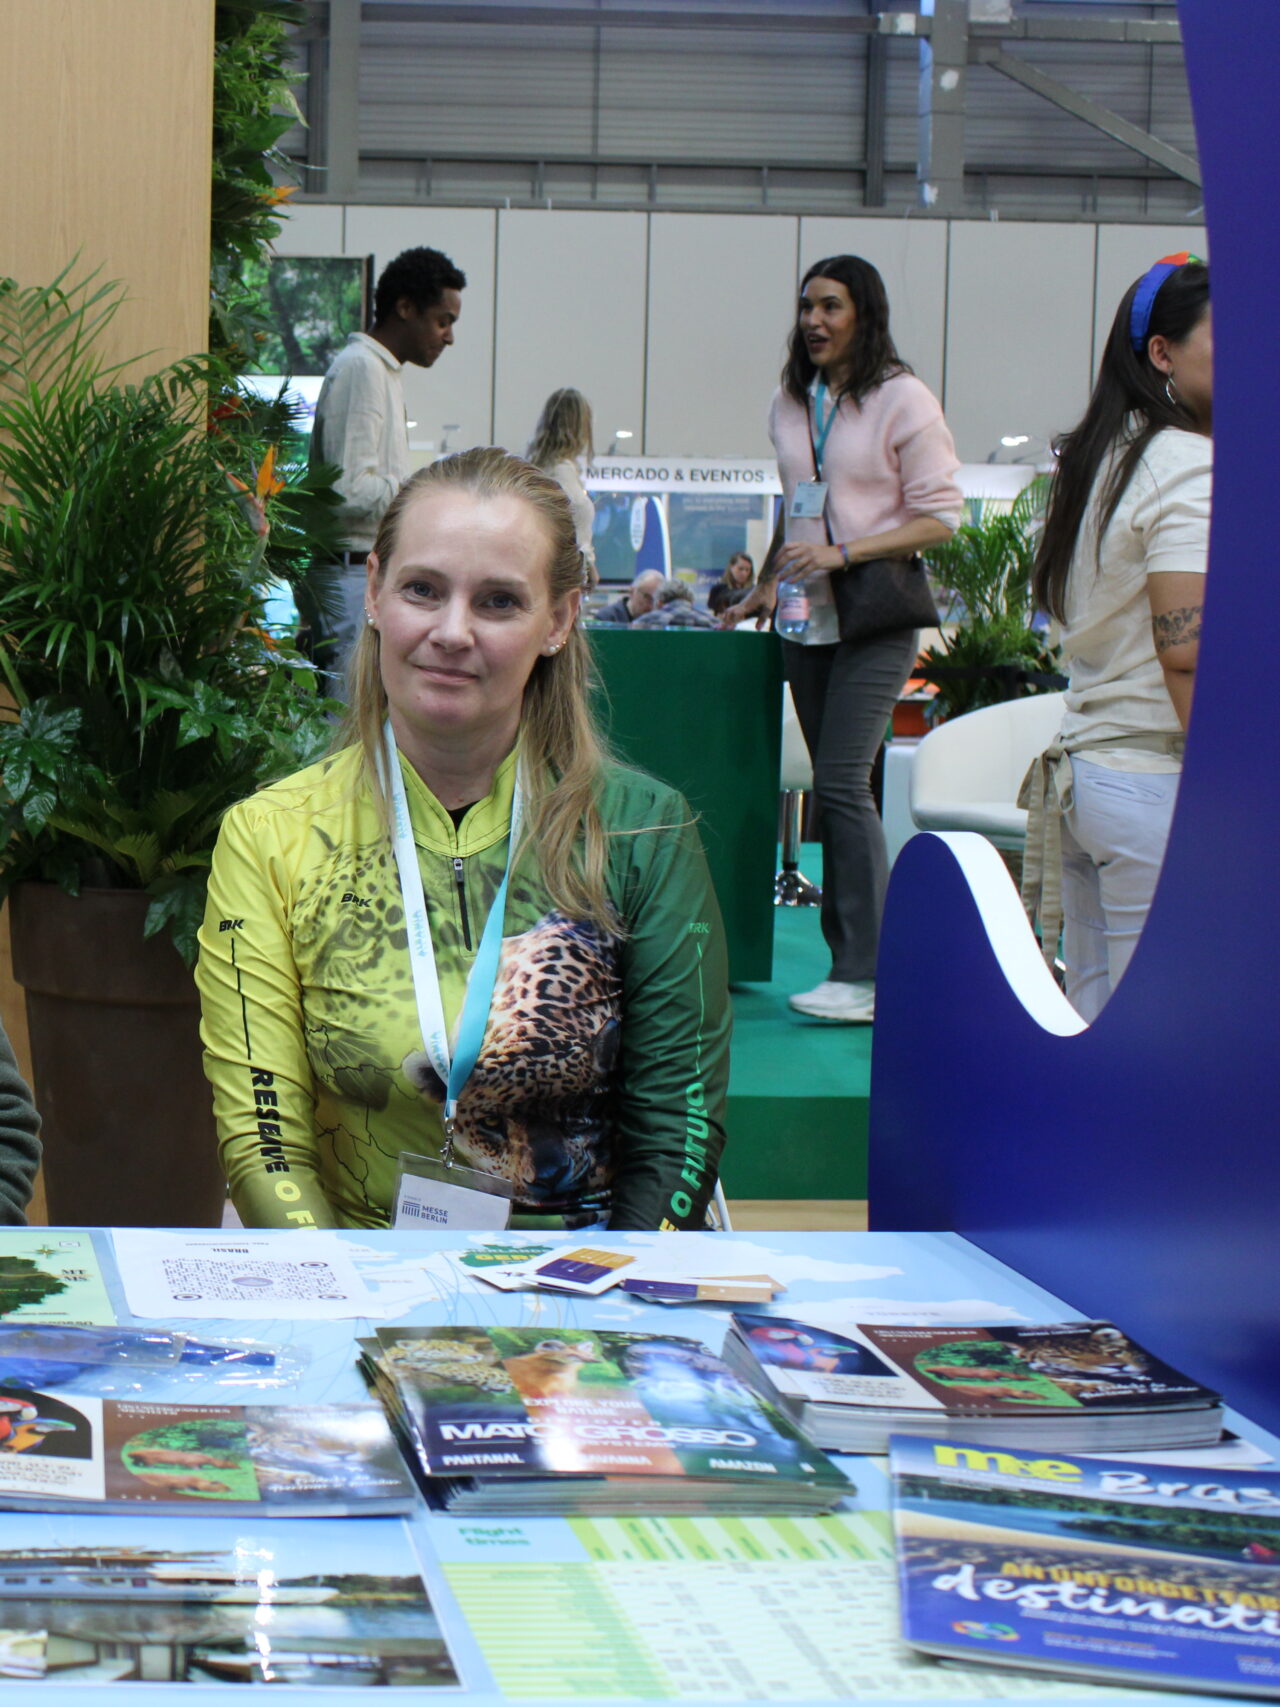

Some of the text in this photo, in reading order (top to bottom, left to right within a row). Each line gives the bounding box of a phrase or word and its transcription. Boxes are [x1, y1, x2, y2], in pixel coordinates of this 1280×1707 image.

[586, 467, 765, 483] MERCADO & EVENTOS
[340, 892, 373, 909] BRK
[218, 918, 245, 933] BRK
[274, 1179, 303, 1203] O
[421, 1205, 449, 1218] MESSE
[670, 1190, 693, 1218] O
[420, 1212, 448, 1226] BERLIN
[441, 1422, 758, 1448] MATO GROSSO
[442, 1453, 525, 1466] PANTANAL
[708, 1457, 778, 1473] AMAZON
